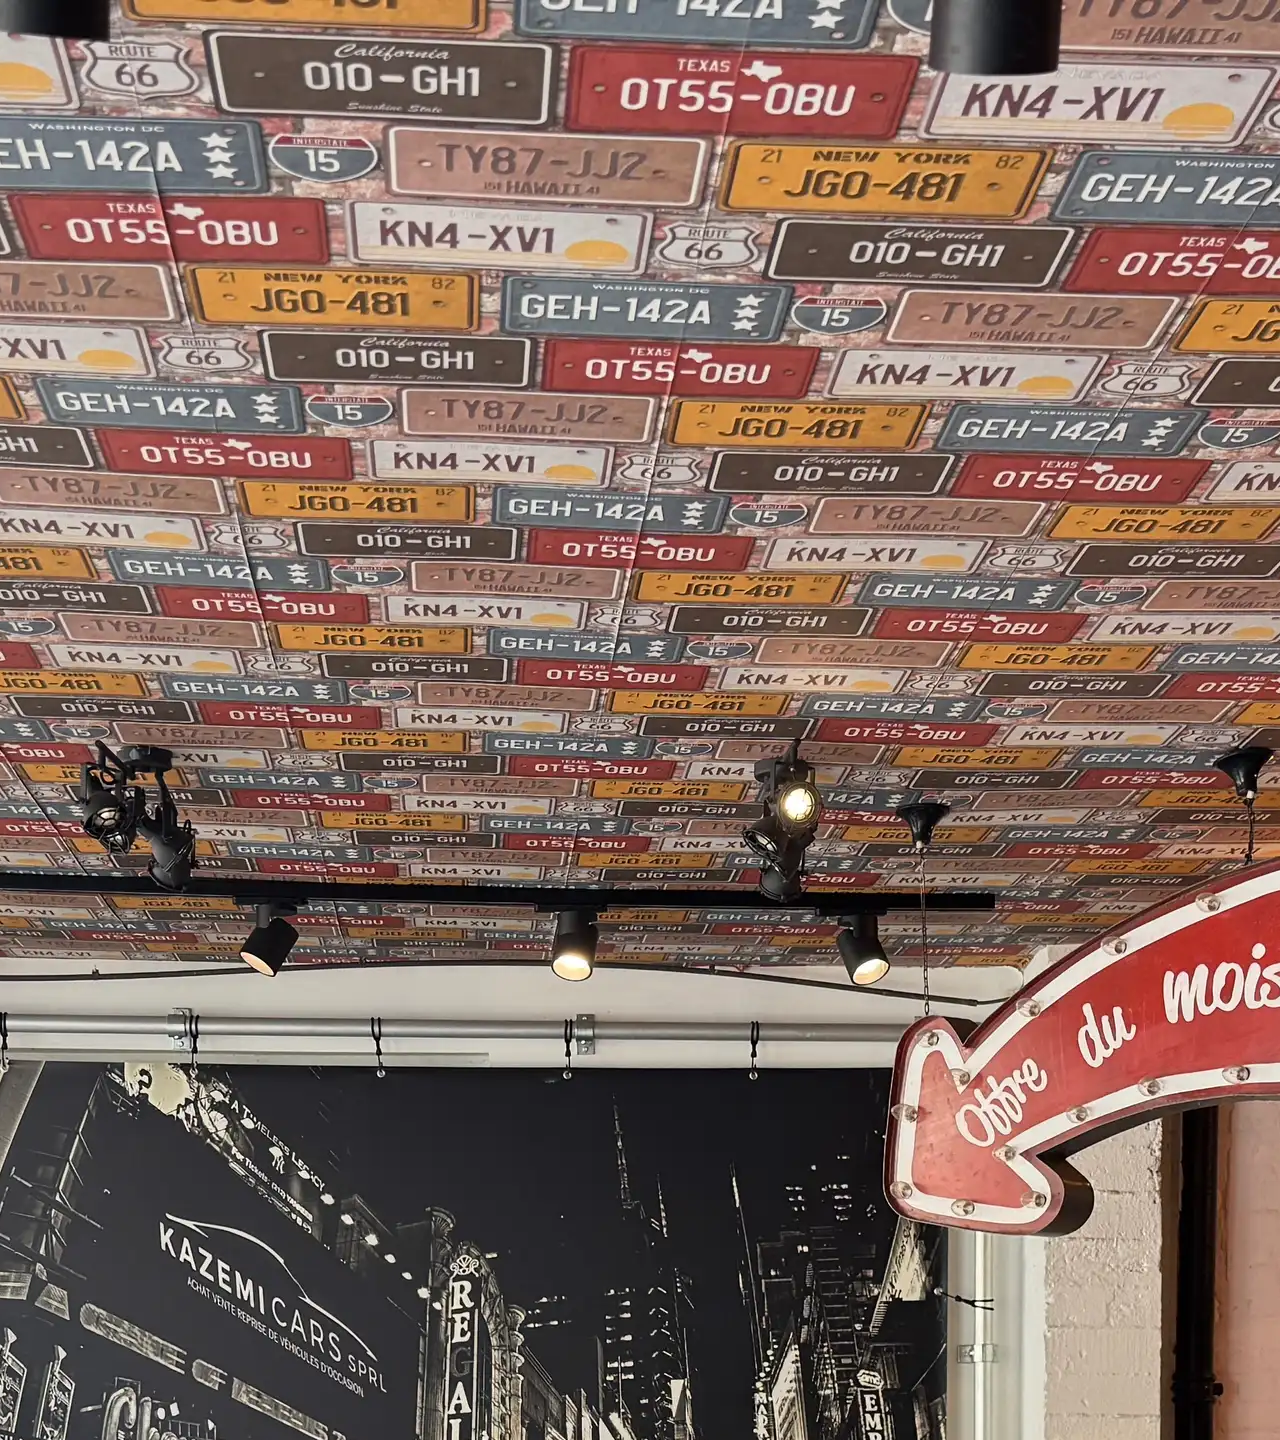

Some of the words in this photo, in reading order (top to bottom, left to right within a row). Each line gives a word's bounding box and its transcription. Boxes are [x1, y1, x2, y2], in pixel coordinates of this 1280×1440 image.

[1134, 26, 1224, 45] HAWAII
[333, 43, 450, 61] California
[677, 57, 732, 73] TEXAS
[113, 67, 160, 86] 66
[304, 149, 341, 173] 15
[761, 149, 783, 162] 21
[993, 156, 1025, 170] 82
[817, 308, 854, 327] 15
[1077, 1003, 1137, 1068] du
[159, 1222, 265, 1315] KAZEMI
[272, 1297, 341, 1362] CARS
[348, 1354, 387, 1393] SPRL
[187, 1276, 211, 1298] ACHAT
[211, 1291, 236, 1316] VENTE
[237, 1308, 268, 1336] REPRISE
[268, 1329, 279, 1343] DE
[320, 1361, 365, 1398] D'OCCASION
